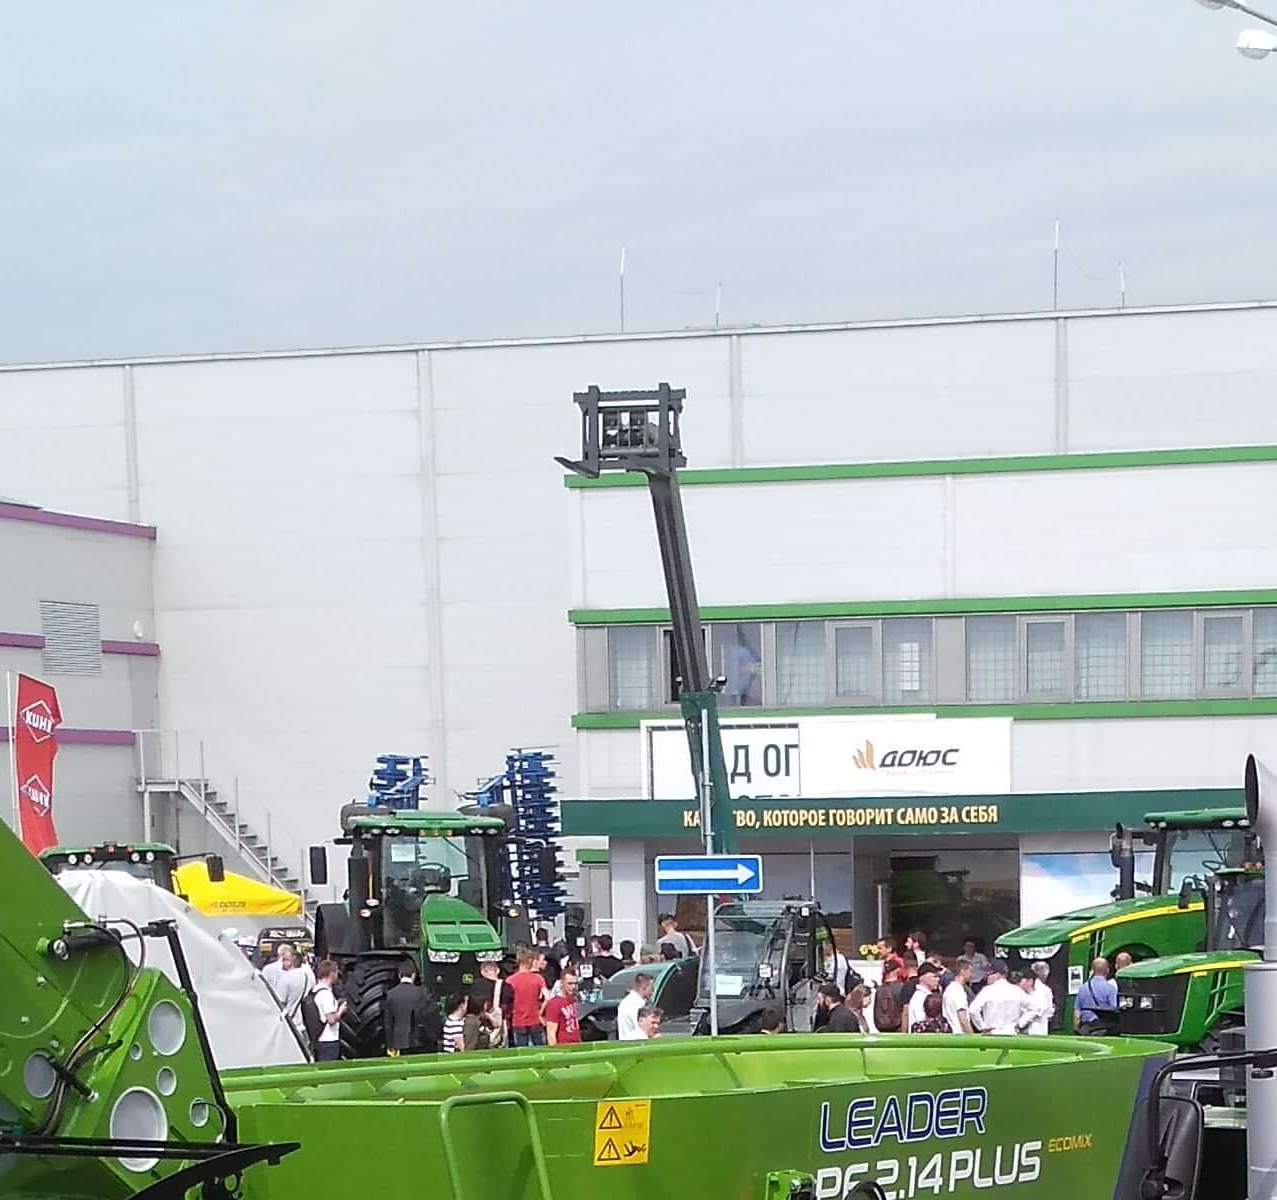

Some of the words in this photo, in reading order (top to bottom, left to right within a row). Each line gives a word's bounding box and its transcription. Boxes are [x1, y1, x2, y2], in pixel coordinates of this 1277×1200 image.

[763, 809, 826, 828] КОТОРОЕ
[828, 808, 894, 827] ГОВОРИТ
[896, 806, 938, 825] САМО
[939, 805, 959, 824] ЗА
[961, 804, 998, 824] СЕБЯ
[820, 1086, 988, 1153] LEADER
[1047, 1133, 1093, 1153] ECOMIX
